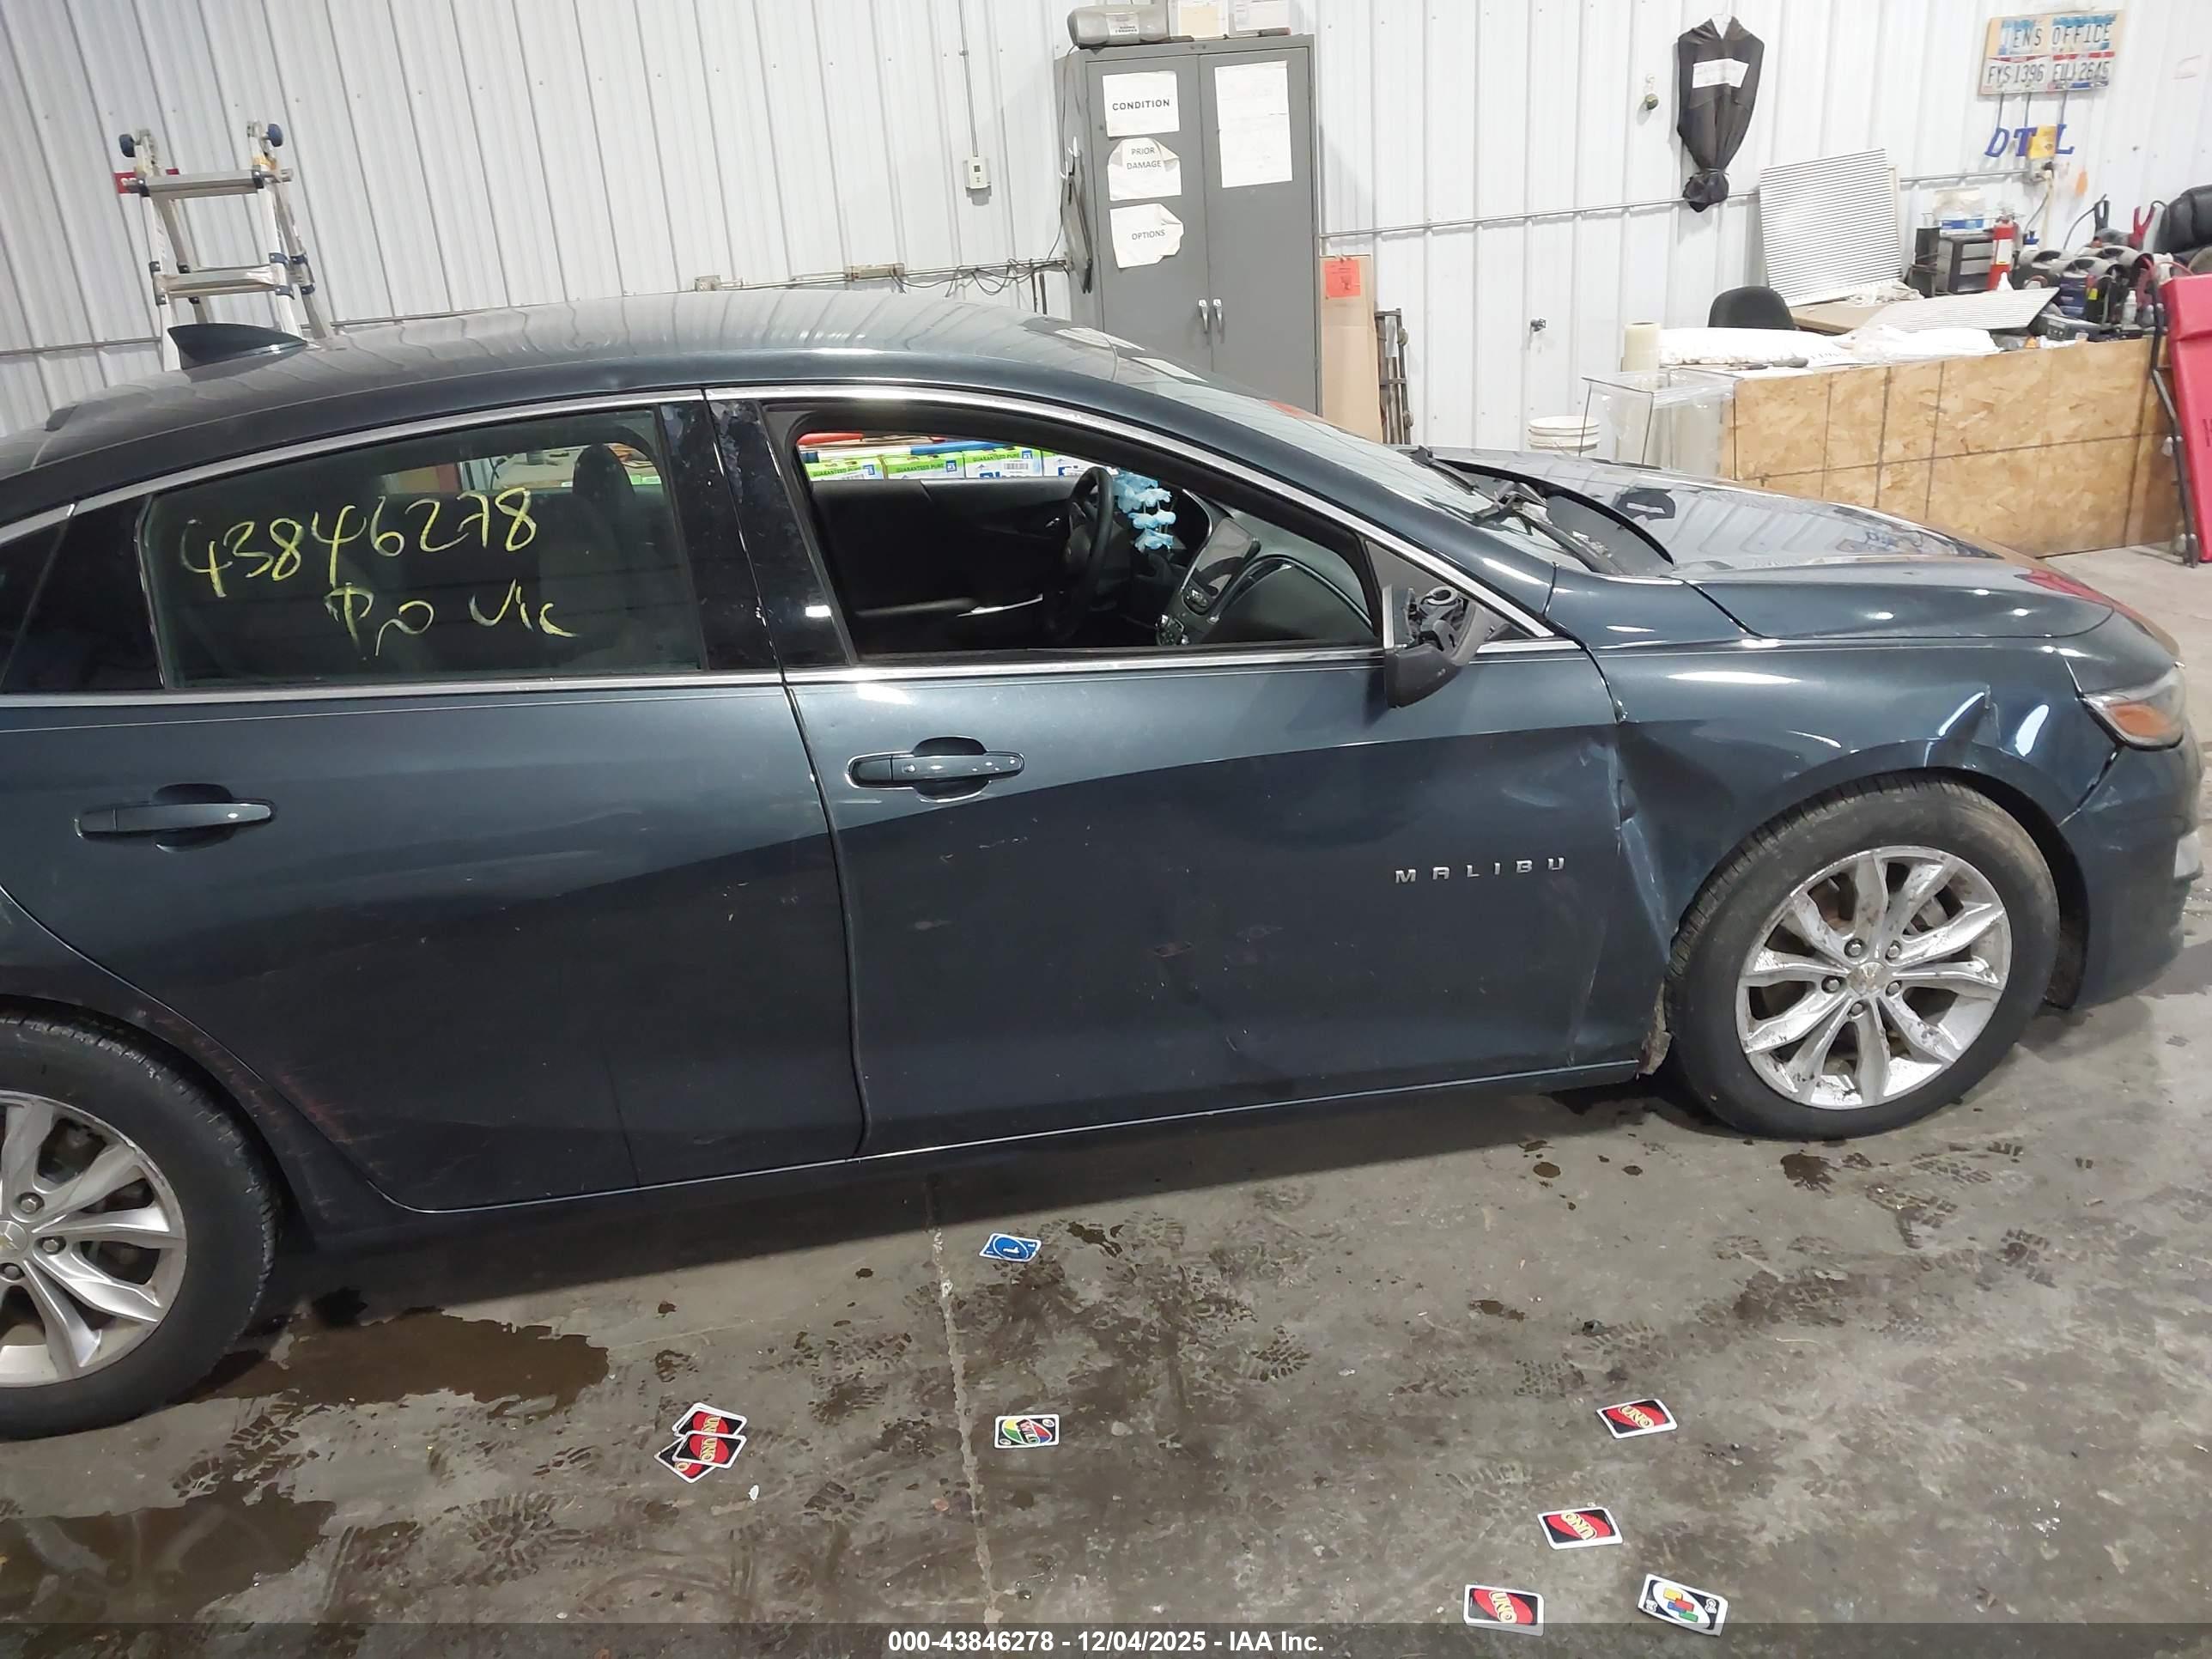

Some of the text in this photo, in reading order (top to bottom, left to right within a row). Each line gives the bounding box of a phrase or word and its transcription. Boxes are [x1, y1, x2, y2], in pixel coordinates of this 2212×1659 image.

[2051, 22, 2112, 46] OFFICE
[1112, 100, 1170, 111] CONDITION
[1131, 146, 1155, 155] PRIOR
[1126, 160, 1162, 169] DAMAGE
[1131, 229, 1165, 240] OPTIONS
[179, 486, 538, 599] 43846278
[1394, 856, 1566, 884] MALIBU
[702, 1415, 721, 1434] UN
[1618, 1405, 1655, 1429] UNO
[700, 1437, 718, 1462] UNO
[1560, 1512, 1597, 1540] UNO
[1488, 1590, 1517, 1623] UNO
